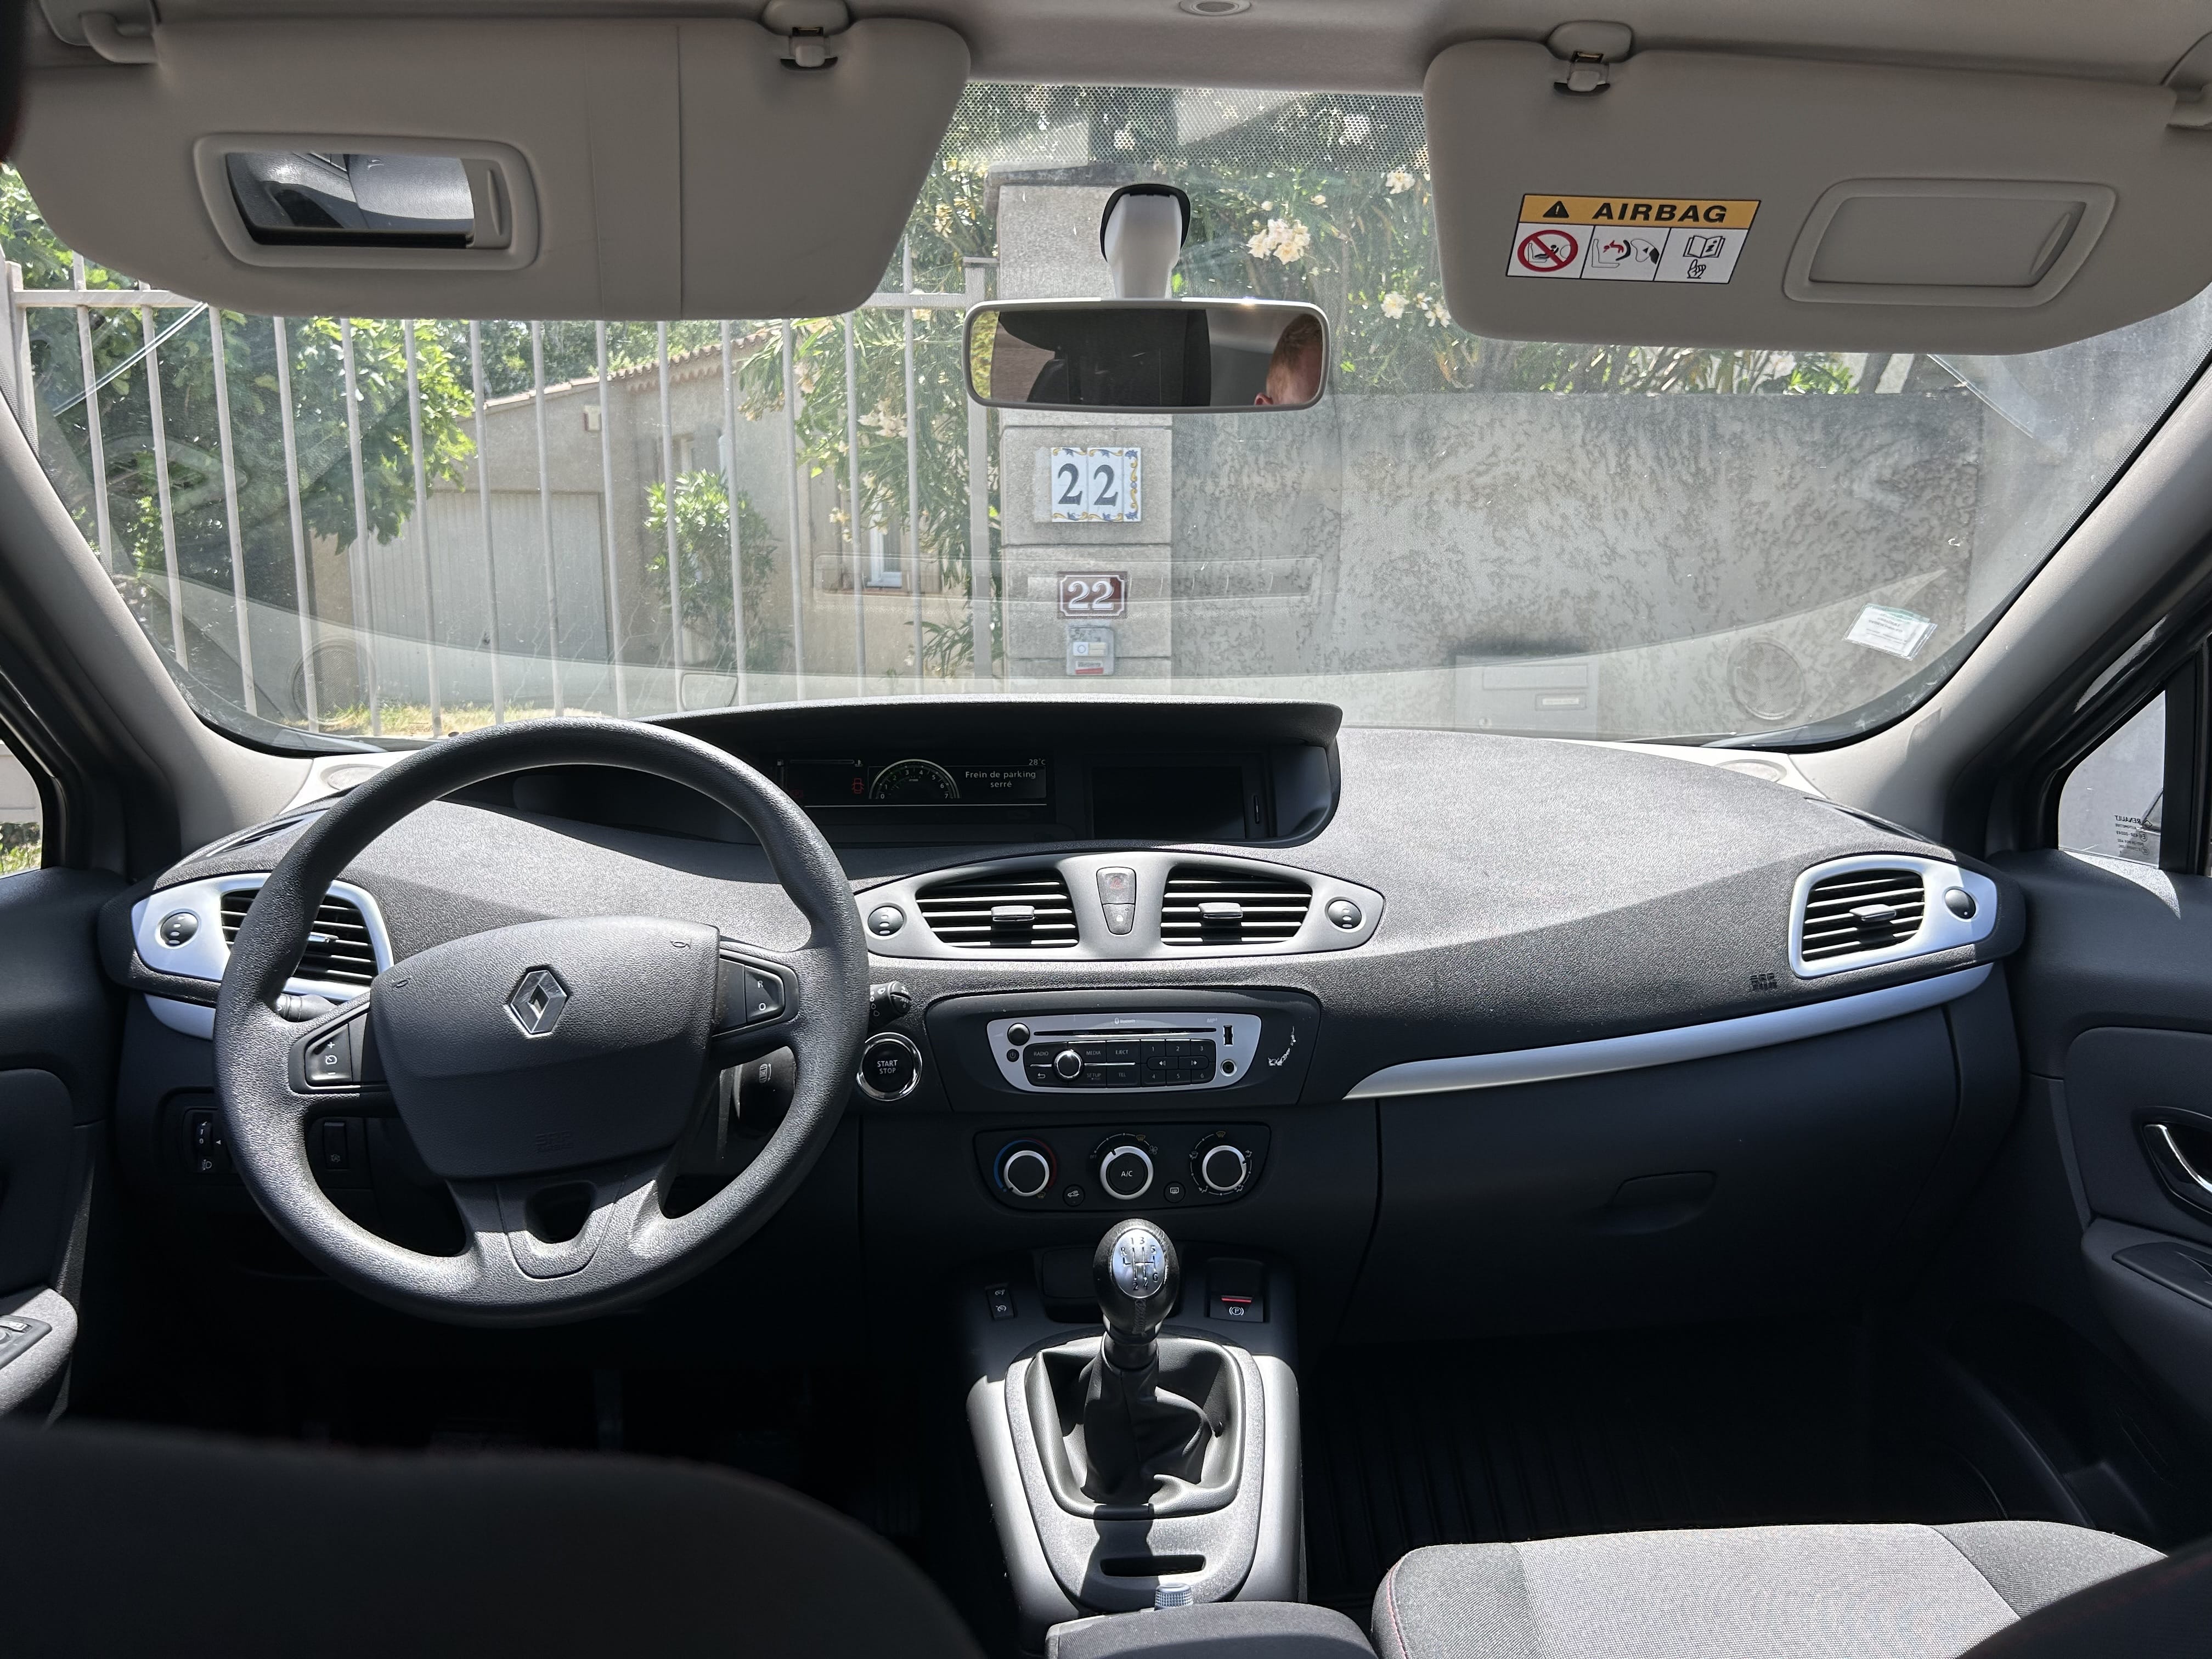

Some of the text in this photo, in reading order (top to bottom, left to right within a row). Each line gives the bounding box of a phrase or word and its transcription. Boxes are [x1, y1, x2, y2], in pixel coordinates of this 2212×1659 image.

[1592, 202, 1727, 224] AIRBAG
[1058, 463, 1118, 507] 22
[1068, 580, 1114, 610] 22
[1029, 758, 1046, 766] 28°C
[1003, 770, 1036, 779] parking
[757, 980, 764, 988] R
[877, 1059, 898, 1068] START
[1139, 1237, 1145, 1245] 3
[1120, 1247, 1127, 1256] R
[1151, 1245, 1156, 1254] 5
[1153, 1272, 1158, 1282] 6
[1132, 1280, 1149, 1290] 2 4
